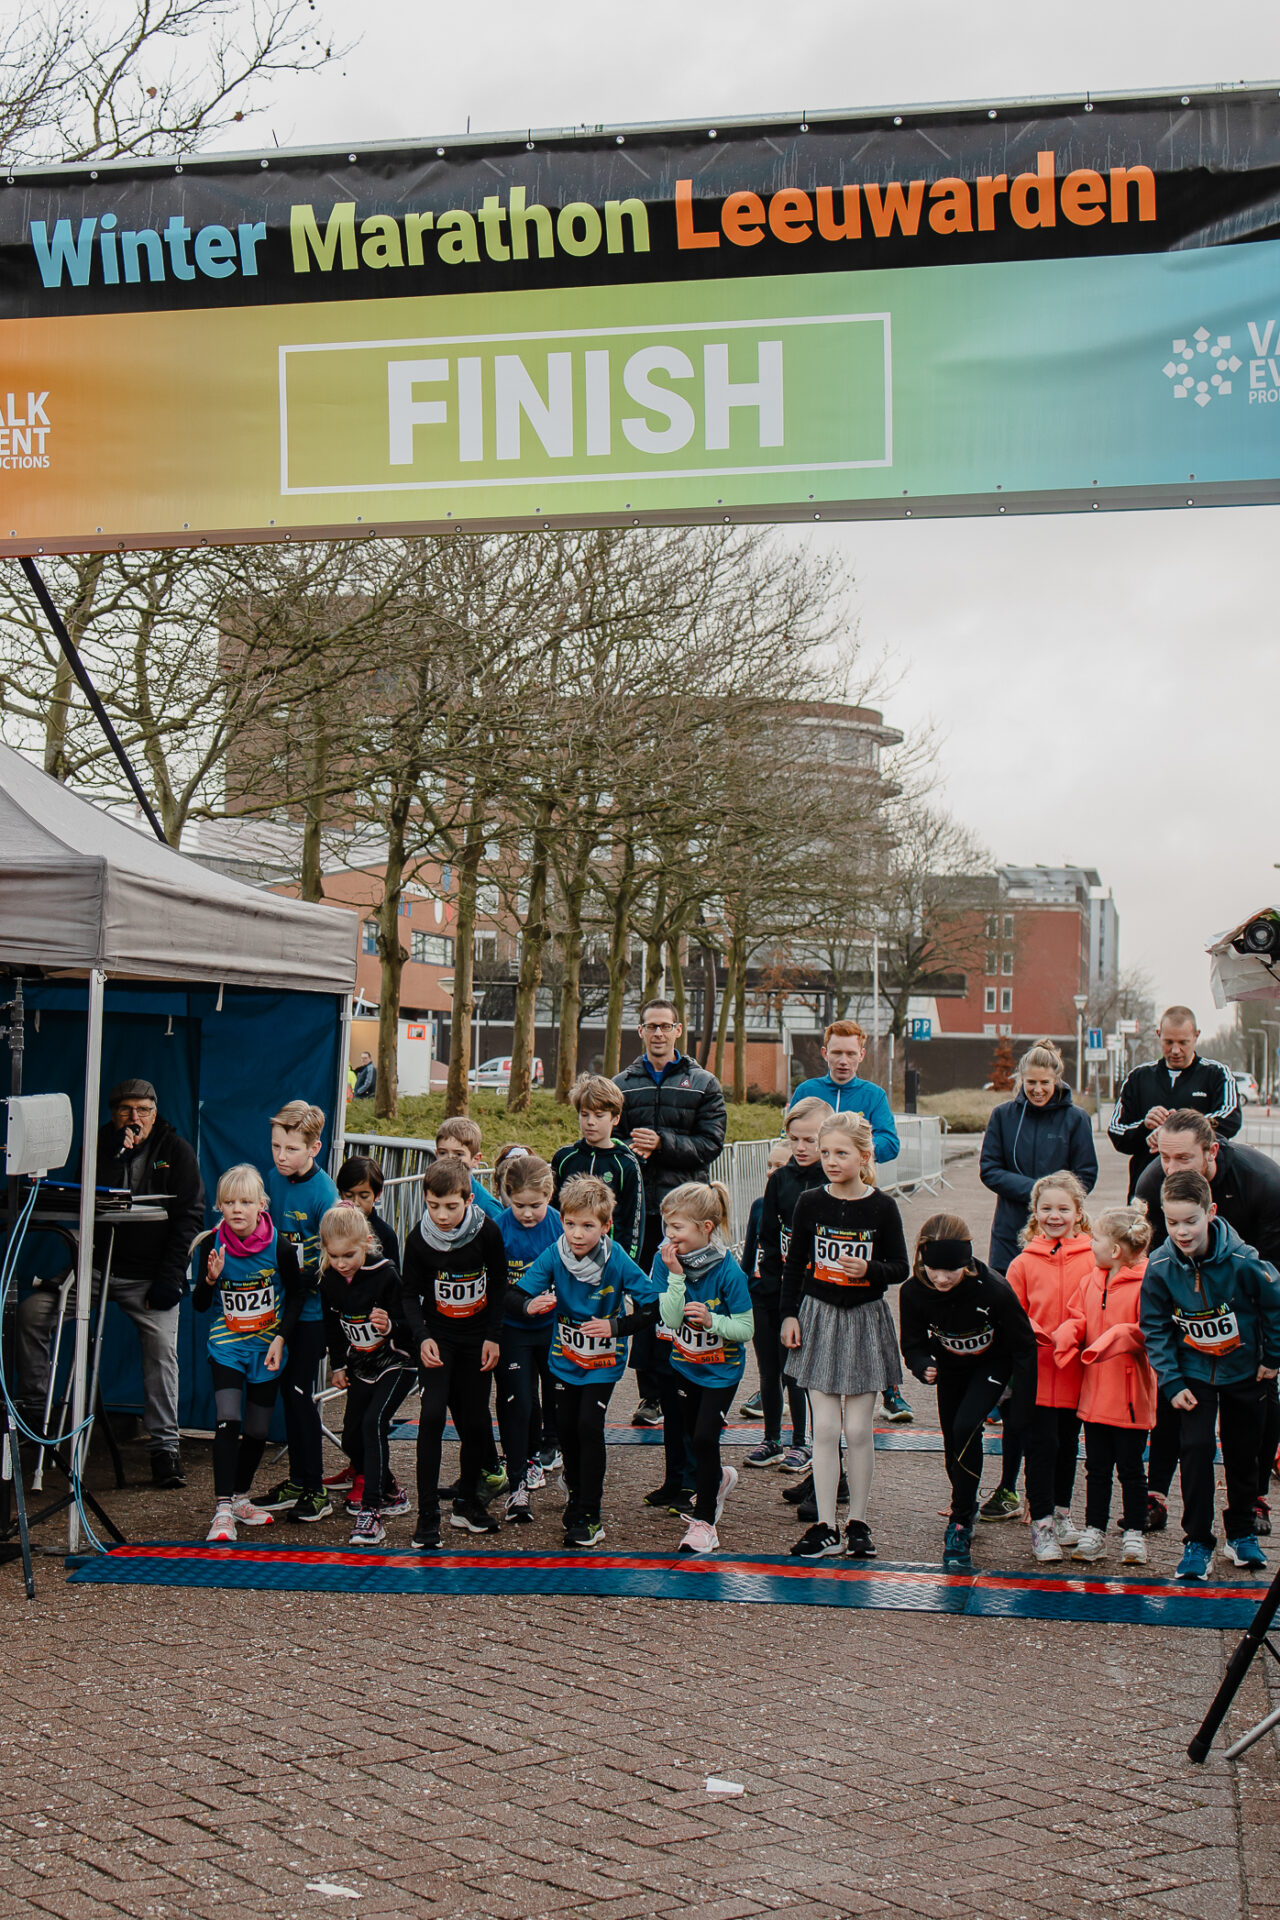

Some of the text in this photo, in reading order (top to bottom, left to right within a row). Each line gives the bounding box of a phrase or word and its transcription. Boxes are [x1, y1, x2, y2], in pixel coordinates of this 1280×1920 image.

[30, 151, 1157, 288] Winter Marathon Leeuwarden
[1247, 320, 1280, 356] V
[387, 339, 785, 466] FINISH
[1248, 388, 1280, 404] PRO
[0, 391, 51, 427] LK
[0, 455, 51, 470] CTIONS
[817, 1239, 868, 1262] 5030
[224, 1288, 272, 1312] 5024
[438, 1276, 486, 1301] 5013
[562, 1326, 612, 1351] 5014
[1176, 1317, 1233, 1338] 5006
